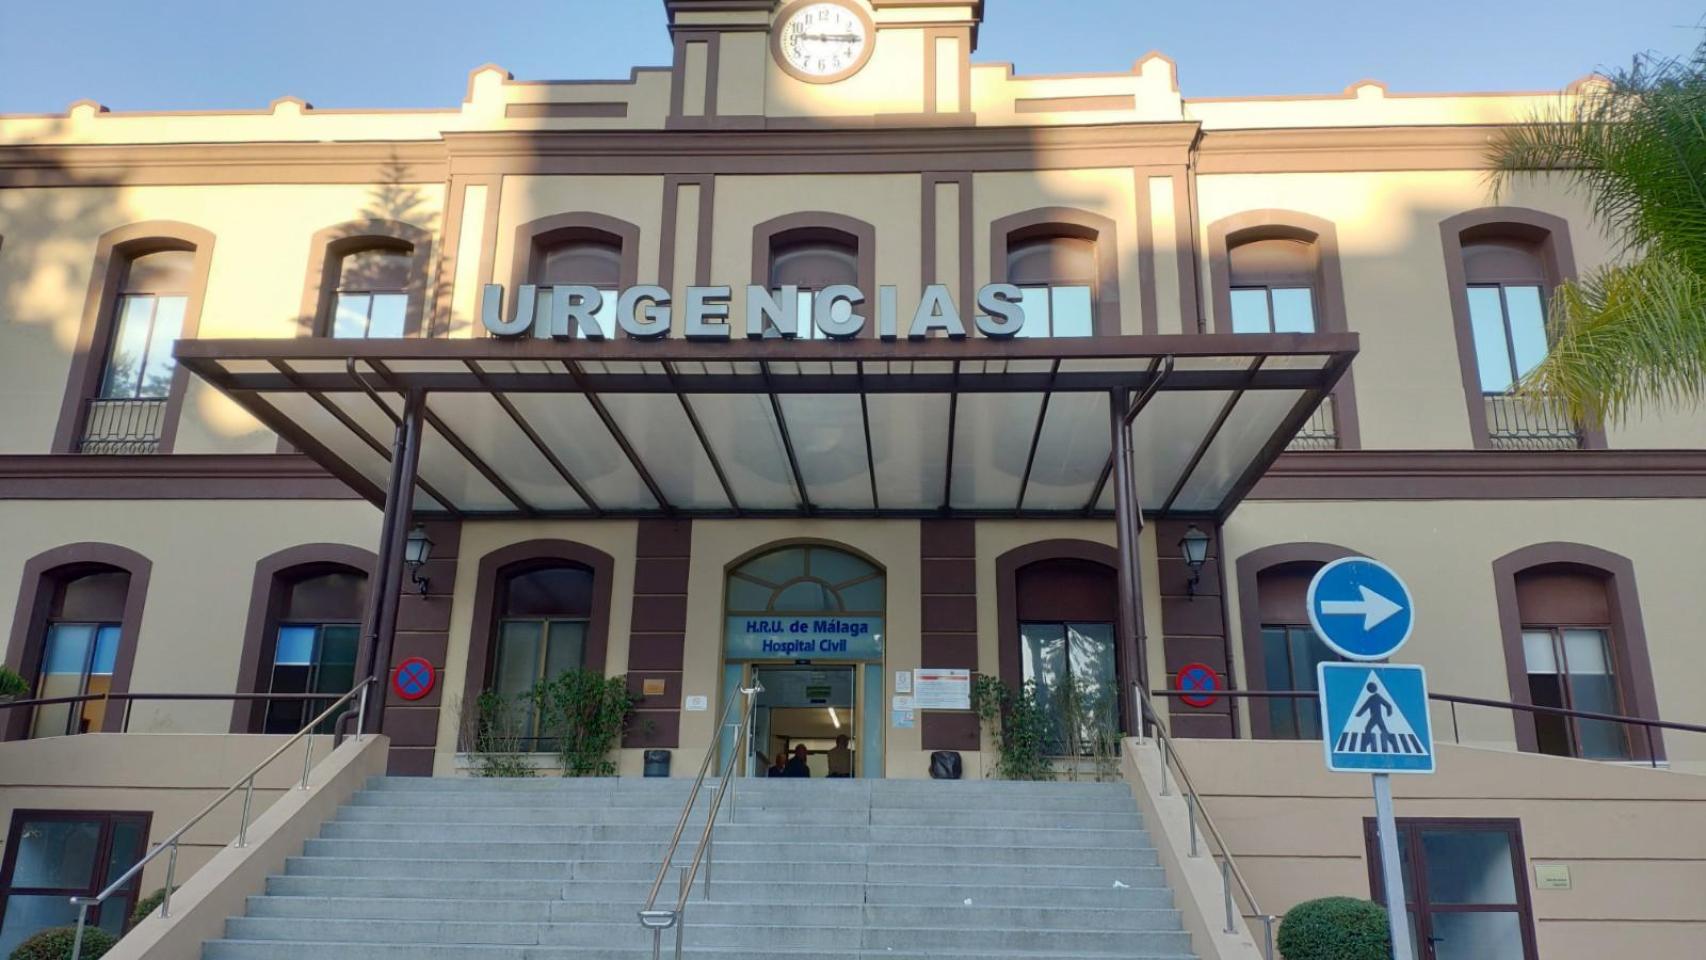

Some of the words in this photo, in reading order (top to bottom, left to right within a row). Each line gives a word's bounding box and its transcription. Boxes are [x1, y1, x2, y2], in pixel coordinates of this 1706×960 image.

[805, 13, 813, 25] 11
[819, 9, 830, 21] 12
[792, 21, 804, 33] 10
[846, 21, 853, 32] 2
[790, 34, 798, 46] 9
[794, 47, 801, 58] 8
[844, 47, 852, 58] 4
[804, 55, 811, 67] 7
[818, 59, 826, 72] 6
[833, 55, 840, 67] 5
[481, 283, 1025, 341] URGENCIAS
[746, 620, 784, 633] H.R.U.
[789, 620, 809, 633] de
[813, 618, 869, 637] Málaga
[762, 639, 816, 655] Hospital
[819, 639, 847, 651] Civil
